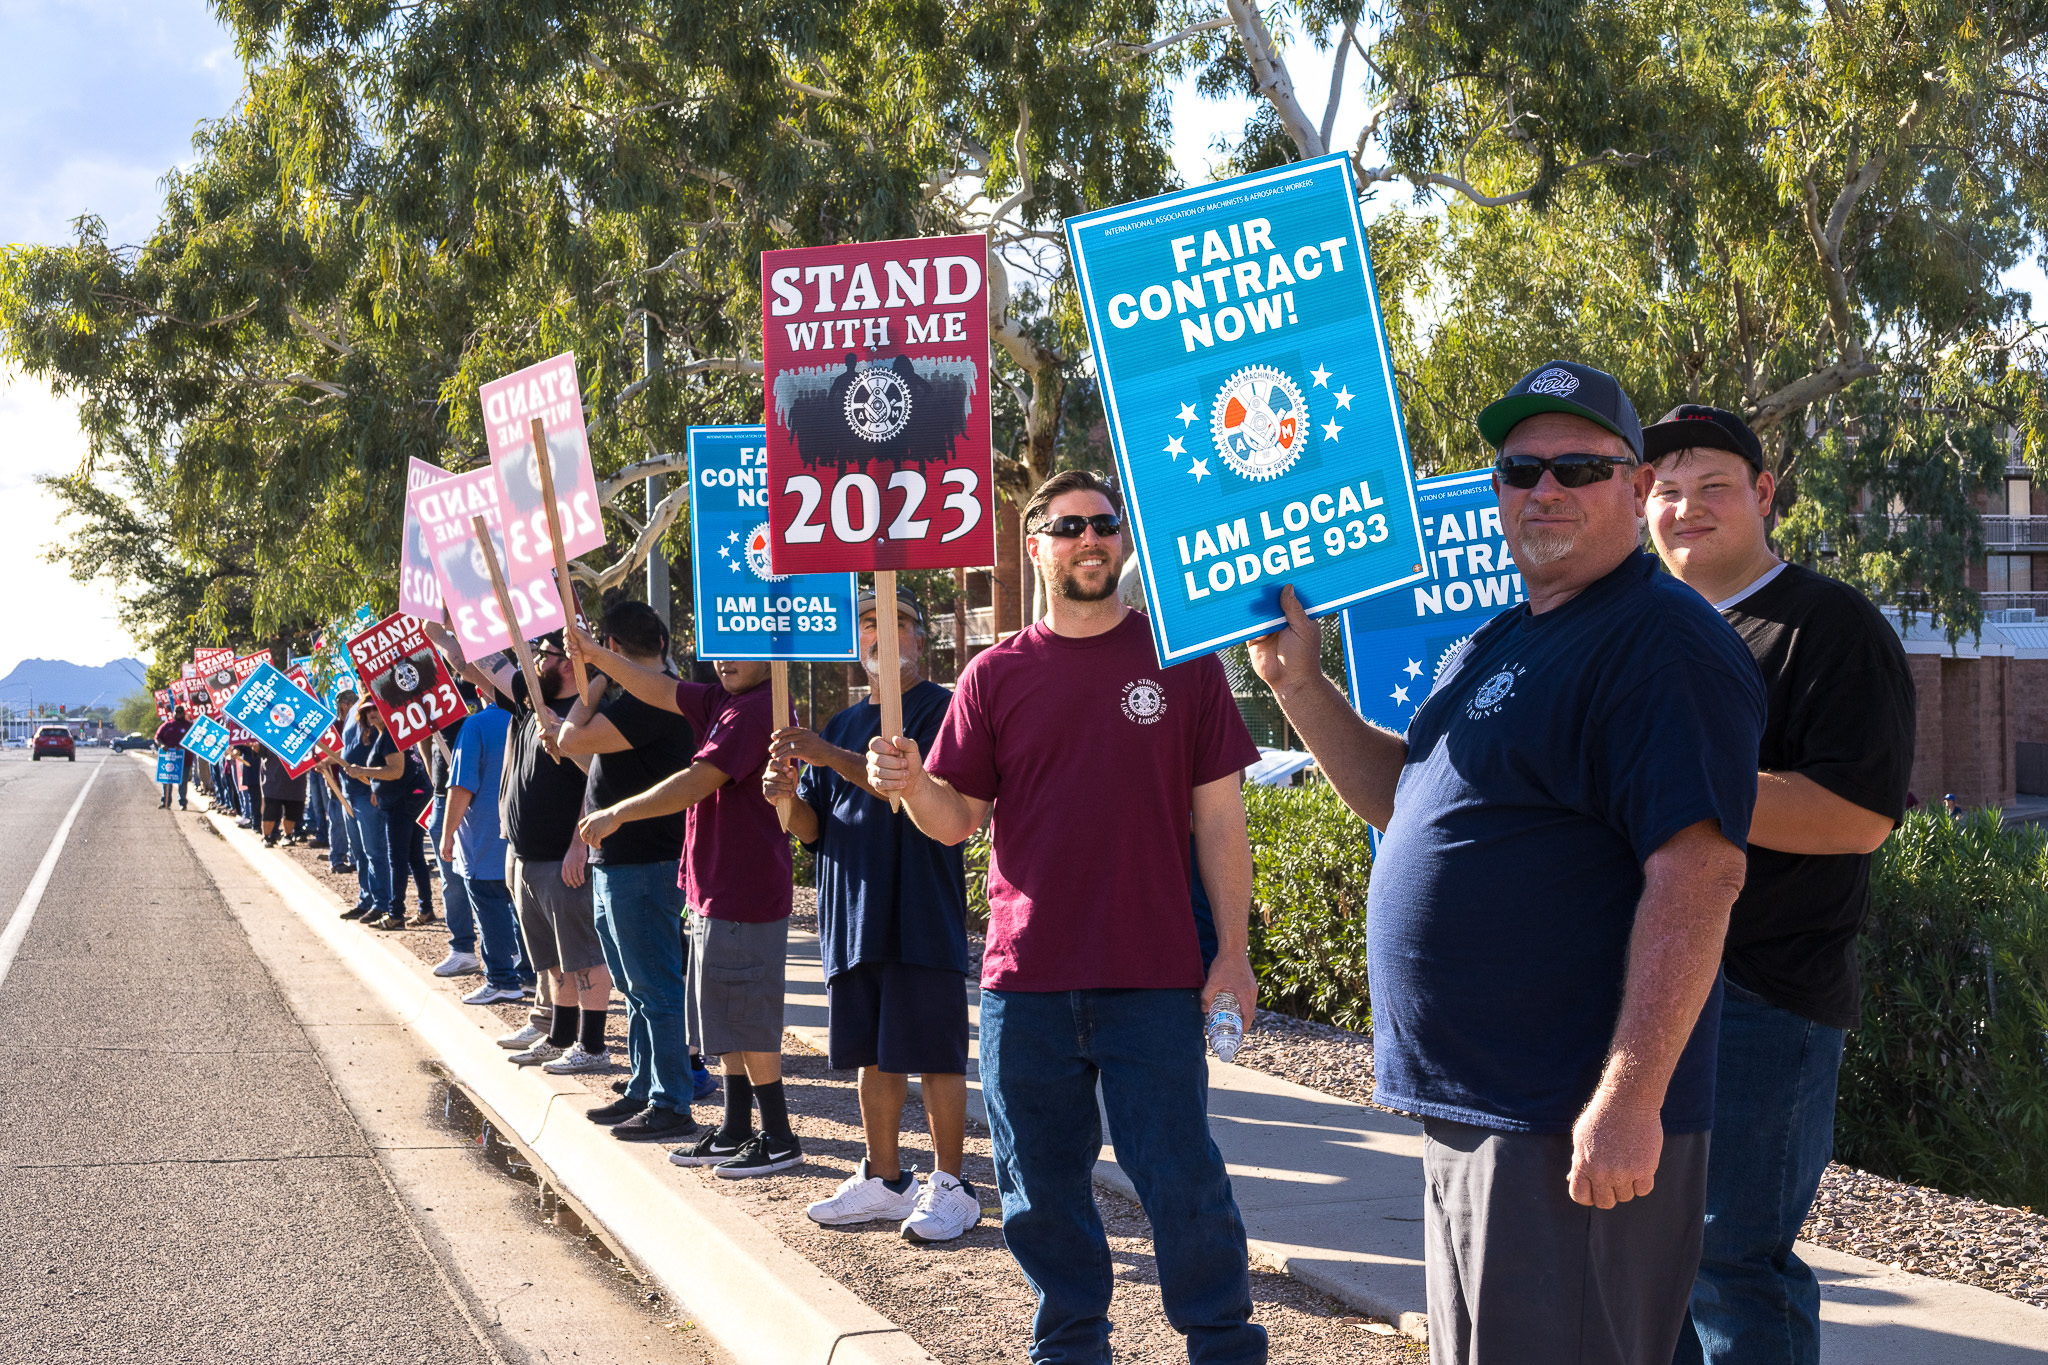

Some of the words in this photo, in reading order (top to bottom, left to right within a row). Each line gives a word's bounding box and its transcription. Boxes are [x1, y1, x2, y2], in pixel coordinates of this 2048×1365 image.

[1104, 218, 1154, 237] INTERNATIONAL
[1155, 207, 1197, 224] ASSOCIATION
[1197, 205, 1205, 213] OF
[1206, 196, 1244, 211] MACHINISTS
[1244, 194, 1250, 202] &
[1250, 185, 1284, 200] AEROSPACE
[1285, 179, 1314, 192] WORKERS
[1171, 217, 1276, 273] FAIR
[770, 255, 982, 316] STAND
[1108, 236, 1348, 329] CONTRACT
[785, 316, 890, 351] WITH
[905, 311, 967, 345] ME
[1180, 290, 1298, 352] NOW!
[1233, 378, 1242, 388] OF
[1243, 372, 1282, 385] MACHINISTS
[1282, 382, 1295, 397] AND
[858, 411, 865, 420] A
[891, 410, 899, 418] M
[1217, 387, 1234, 436] ASSOCIATION
[1293, 398, 1304, 441] AEROSPACE
[1236, 437, 1247, 453] A
[1281, 423, 1293, 440] M
[740, 447, 768, 466] FA
[1220, 438, 1263, 474] INTERNATIONAL
[1273, 443, 1299, 471] WORKERS
[701, 468, 768, 487] CONT
[738, 488, 769, 507] NO
[782, 467, 982, 544] 2023
[1447, 486, 1482, 498] MACHINISTS
[1177, 518, 1250, 565] IAM
[1259, 480, 1384, 540] LOCAL
[1184, 535, 1314, 601] LODGE
[1323, 513, 1389, 556] 933
[716, 597, 756, 613] IAM
[763, 596, 837, 613] LOCAL
[1413, 573, 1524, 616] NOW!
[717, 615, 791, 632] LODGE
[797, 615, 837, 632] 933
[352, 614, 420, 664] STAND
[364, 645, 401, 673] WITH
[401, 632, 424, 653] ME
[197, 650, 235, 671] STAND
[234, 652, 272, 672] STAND
[212, 685, 238, 704] 202
[238, 673, 279, 720] CONTRACT
[242, 681, 263, 702] FAIR
[1122, 681, 1135, 693] IAM
[1138, 679, 1164, 693] STRONG
[254, 689, 277, 714] NOW!
[390, 683, 457, 740] 2023
[1120, 702, 1136, 722] LOCAL
[1138, 713, 1161, 724] LODGE
[231, 728, 256, 741] 20
[281, 733, 297, 749] IAM
[294, 709, 318, 734] LOCAL
[287, 727, 312, 754] LODGE
